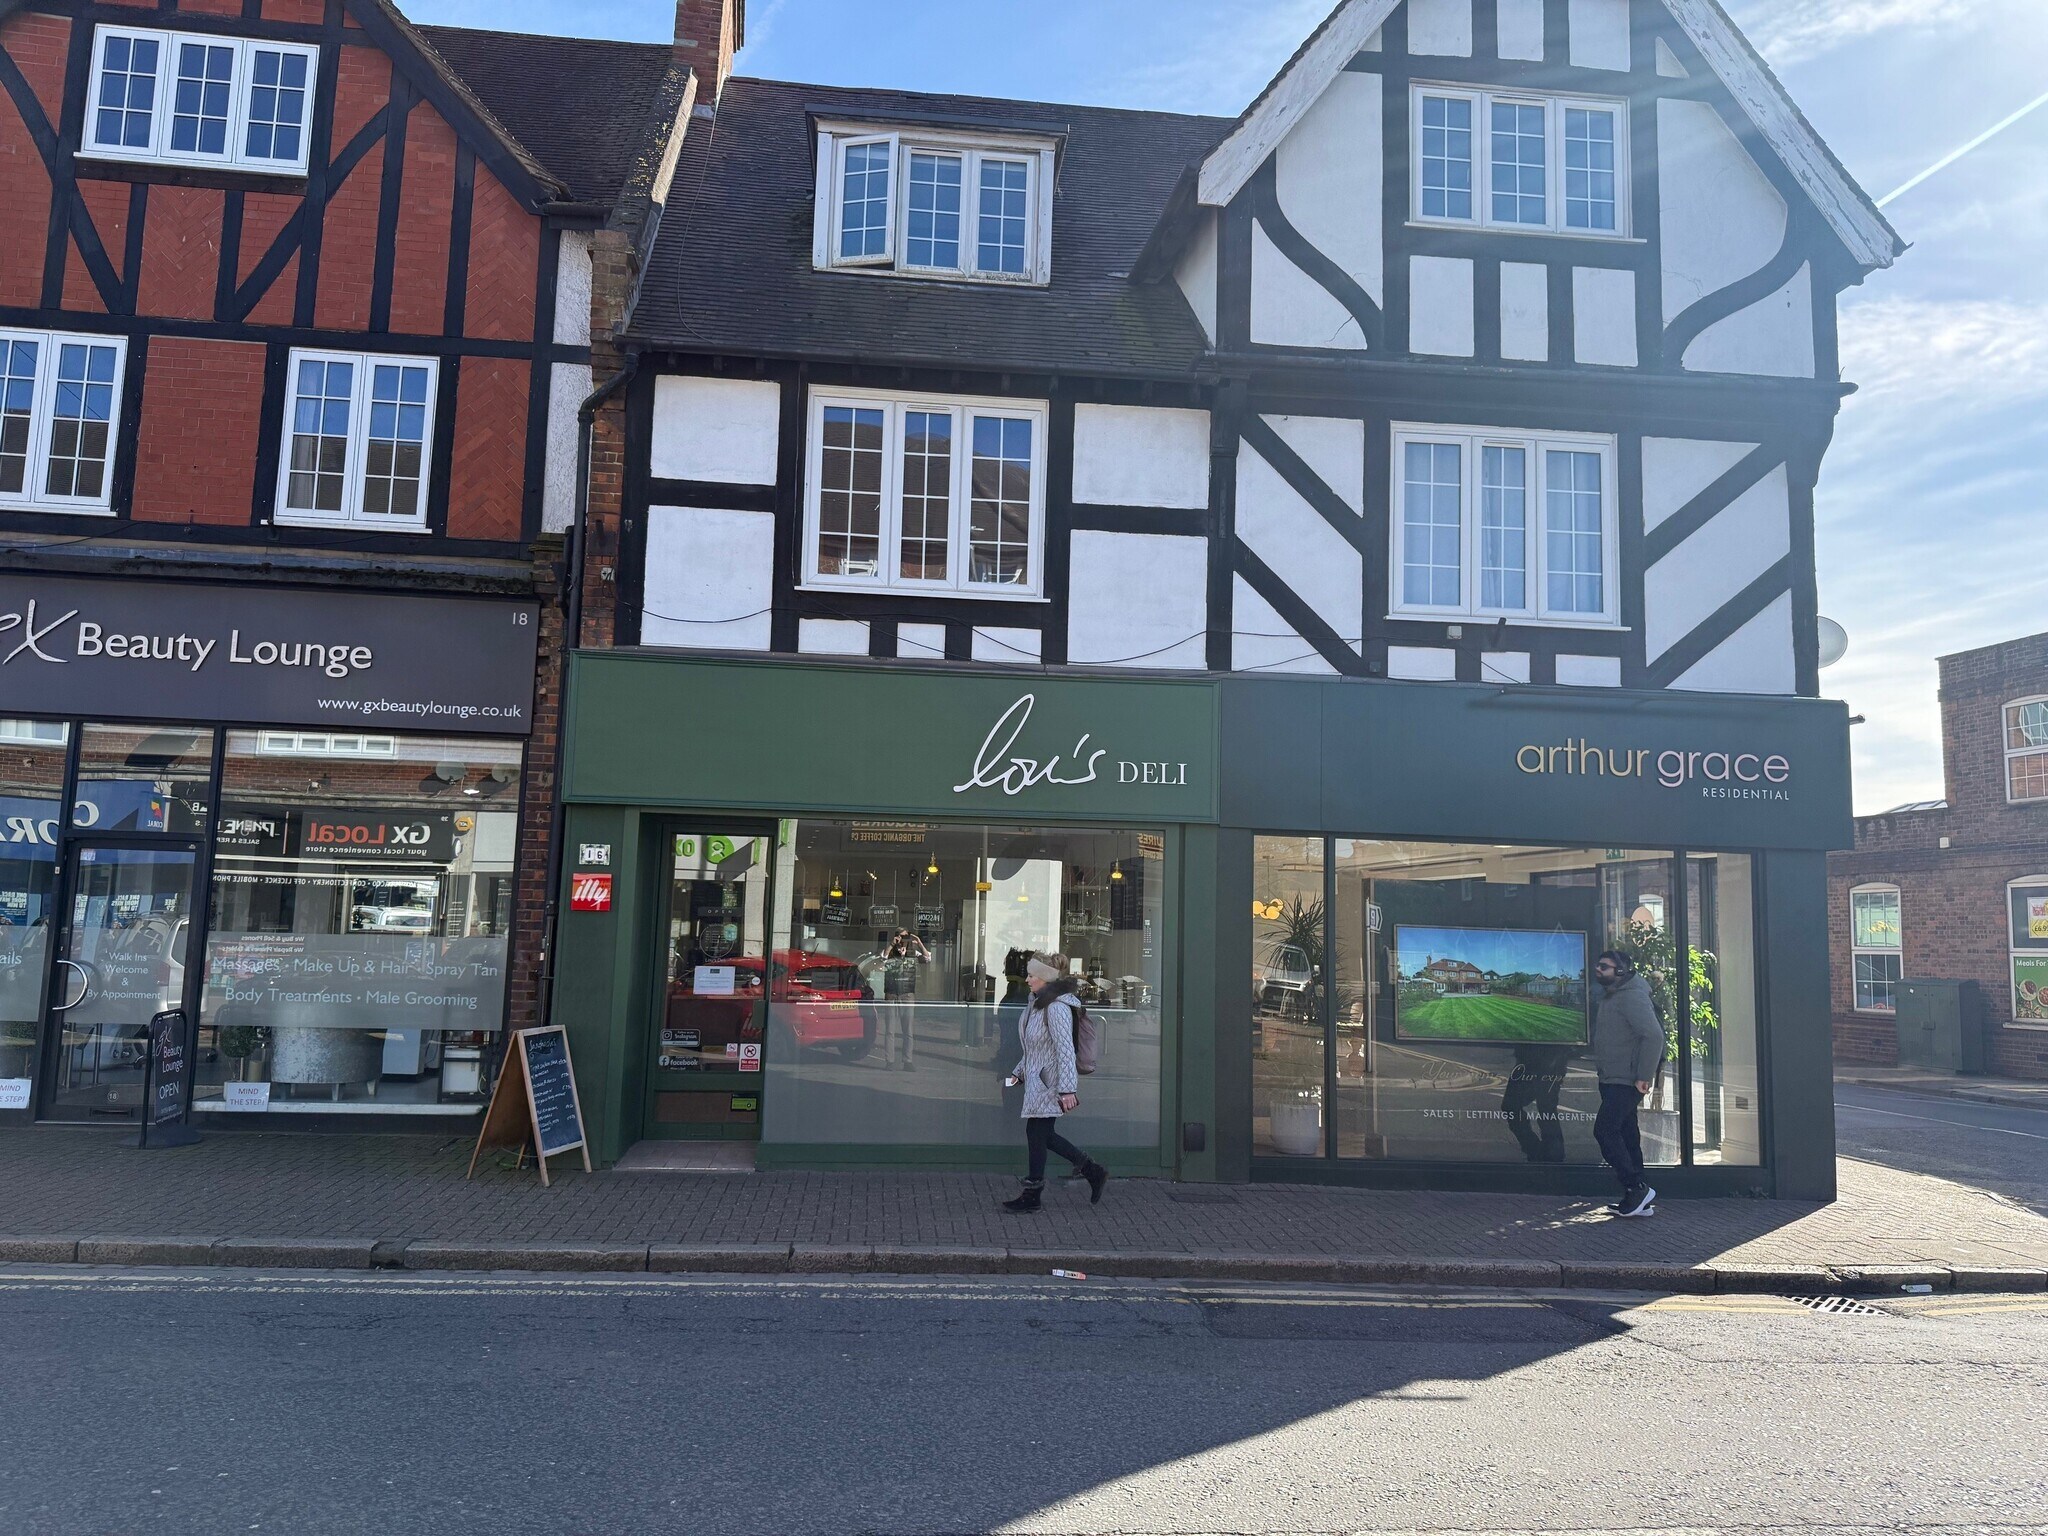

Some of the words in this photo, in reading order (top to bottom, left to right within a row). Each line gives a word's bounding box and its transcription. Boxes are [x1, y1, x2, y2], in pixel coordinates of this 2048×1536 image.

[512, 612, 528, 625] 18
[77, 621, 217, 671] Beauty
[229, 629, 373, 678] Lounge
[317, 698, 522, 719] www.gxbeautylounge.co.uk
[1516, 738, 1650, 777] arthur
[1657, 750, 1790, 788] grace
[1117, 761, 1188, 785] DELI
[1702, 787, 1790, 801] RESIDENTIAL
[588, 850, 603, 859] 16
[574, 879, 608, 907] illy
[0, 951, 22, 965] ails
[108, 952, 132, 961] Walk
[134, 953, 148, 961] Ins
[105, 964, 149, 974] Welcome
[212, 956, 280, 974] Massages
[294, 958, 333, 972] Make
[338, 959, 360, 976] Up
[364, 960, 376, 973] &
[381, 961, 410, 974] Hair
[426, 962, 466, 980] Spray
[470, 962, 498, 977] Tan
[121, 977, 129, 986] &
[87, 988, 99, 1000] By
[101, 989, 161, 1001] Appointment
[225, 987, 263, 1005] Body
[268, 988, 352, 1003] Treatments
[366, 990, 400, 1005] Male
[405, 991, 478, 1010] Grooming
[162, 1059, 184, 1073] Lounge
[1510, 1063, 1539, 1081] Our
[159, 1081, 180, 1099] OPEN
[238, 1087, 259, 1095] MIND
[1423, 1109, 1454, 1118] SALES
[1466, 1110, 1515, 1120] LETTINGS
[1526, 1112, 1598, 1122] MANAGEMENT
